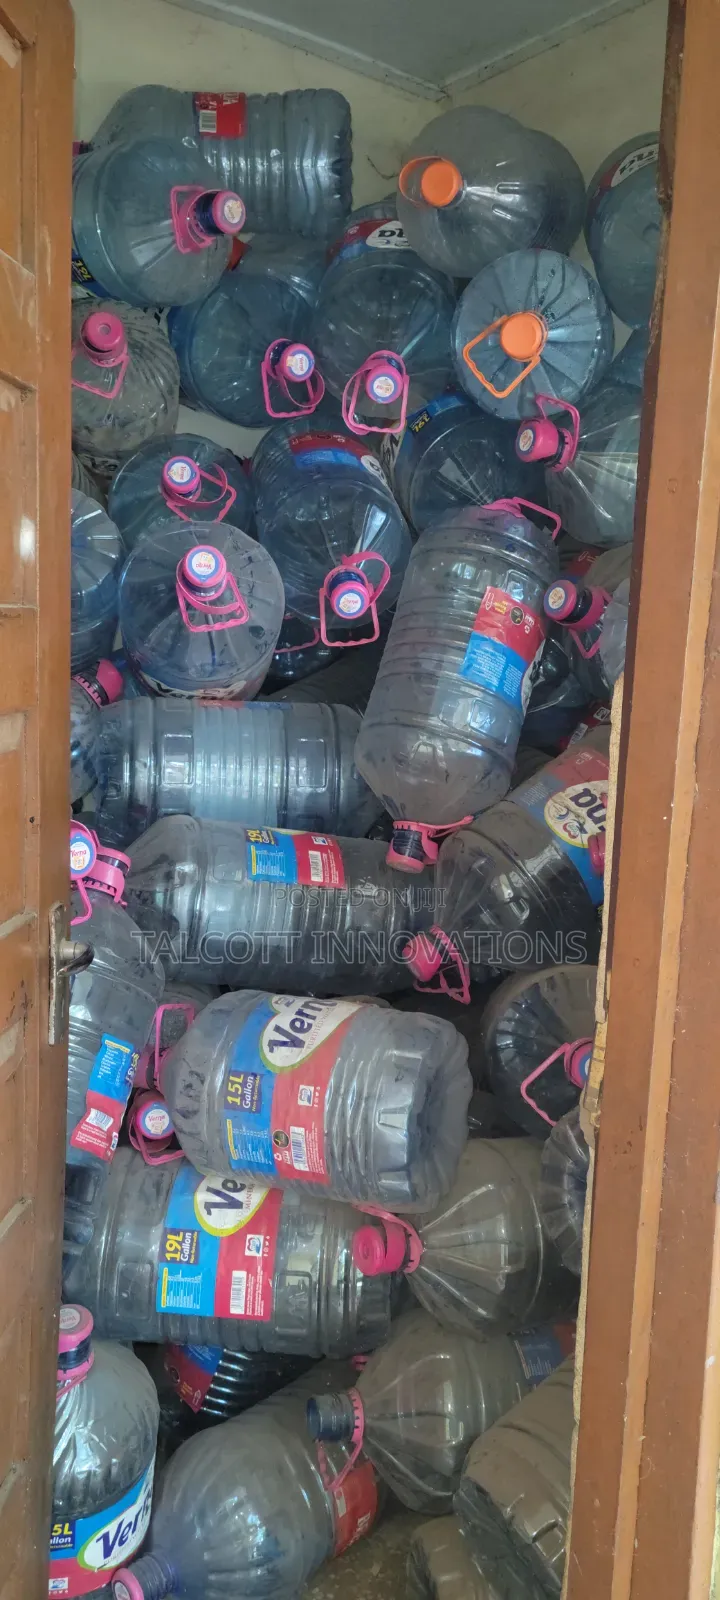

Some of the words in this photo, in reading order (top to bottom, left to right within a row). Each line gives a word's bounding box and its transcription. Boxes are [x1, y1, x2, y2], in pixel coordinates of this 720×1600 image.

[227, 1073, 244, 1106] 15L
[243, 1075, 254, 1109] Gallon
[165, 1231, 184, 1262] 19L
[180, 1232, 192, 1262] Gallon
[51, 1522, 73, 1536] 5L
